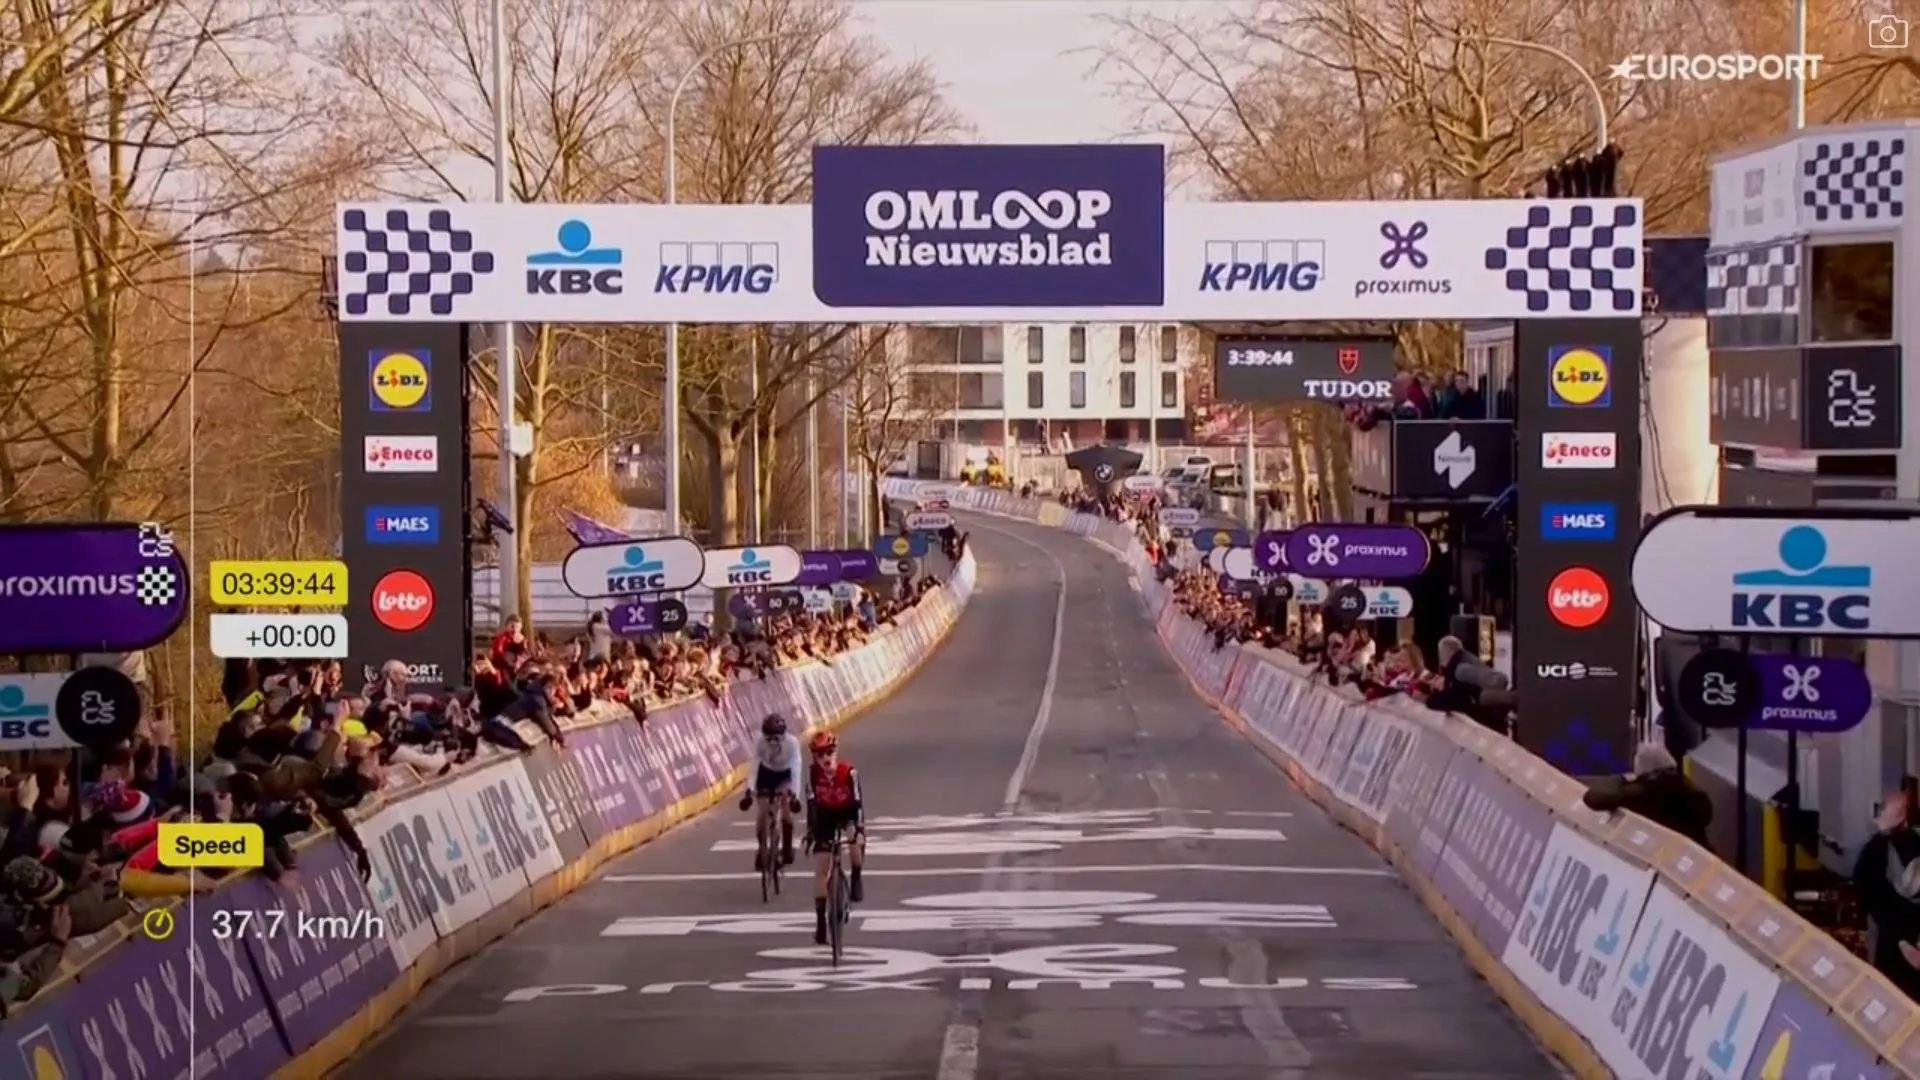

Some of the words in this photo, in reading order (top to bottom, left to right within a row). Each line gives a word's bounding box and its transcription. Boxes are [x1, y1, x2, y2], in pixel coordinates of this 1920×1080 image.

[865, 190, 1111, 230] OMLOOP
[865, 233, 1112, 266] Nieuwsblad
[526, 269, 623, 294] KBC
[654, 264, 774, 293] KPMG
[1199, 261, 1320, 291] KPMG
[1354, 277, 1452, 298] proximus
[1227, 349, 1294, 366] 3:39:44
[1304, 379, 1392, 398] TUDOR
[382, 446, 434, 460] Eneco
[1558, 444, 1612, 457] Eneco
[386, 517, 430, 531] MAES
[1562, 514, 1606, 528] MAES
[1345, 543, 1408, 557] proximus
[607, 573, 665, 593] KBC
[728, 570, 772, 584] KBC
[769, 597, 783, 609] 50
[1341, 597, 1358, 609] 25
[1731, 593, 1870, 629] KBC
[662, 610, 679, 622] 25
[1537, 664, 1567, 678] UCI
[1762, 705, 1838, 721] proximus
[477, 779, 538, 874] KBC
[379, 814, 456, 930] KBC
[1529, 855, 1610, 987] KBC
[503, 977, 1418, 1001] proximus
[1628, 929, 1727, 1080] KBC
